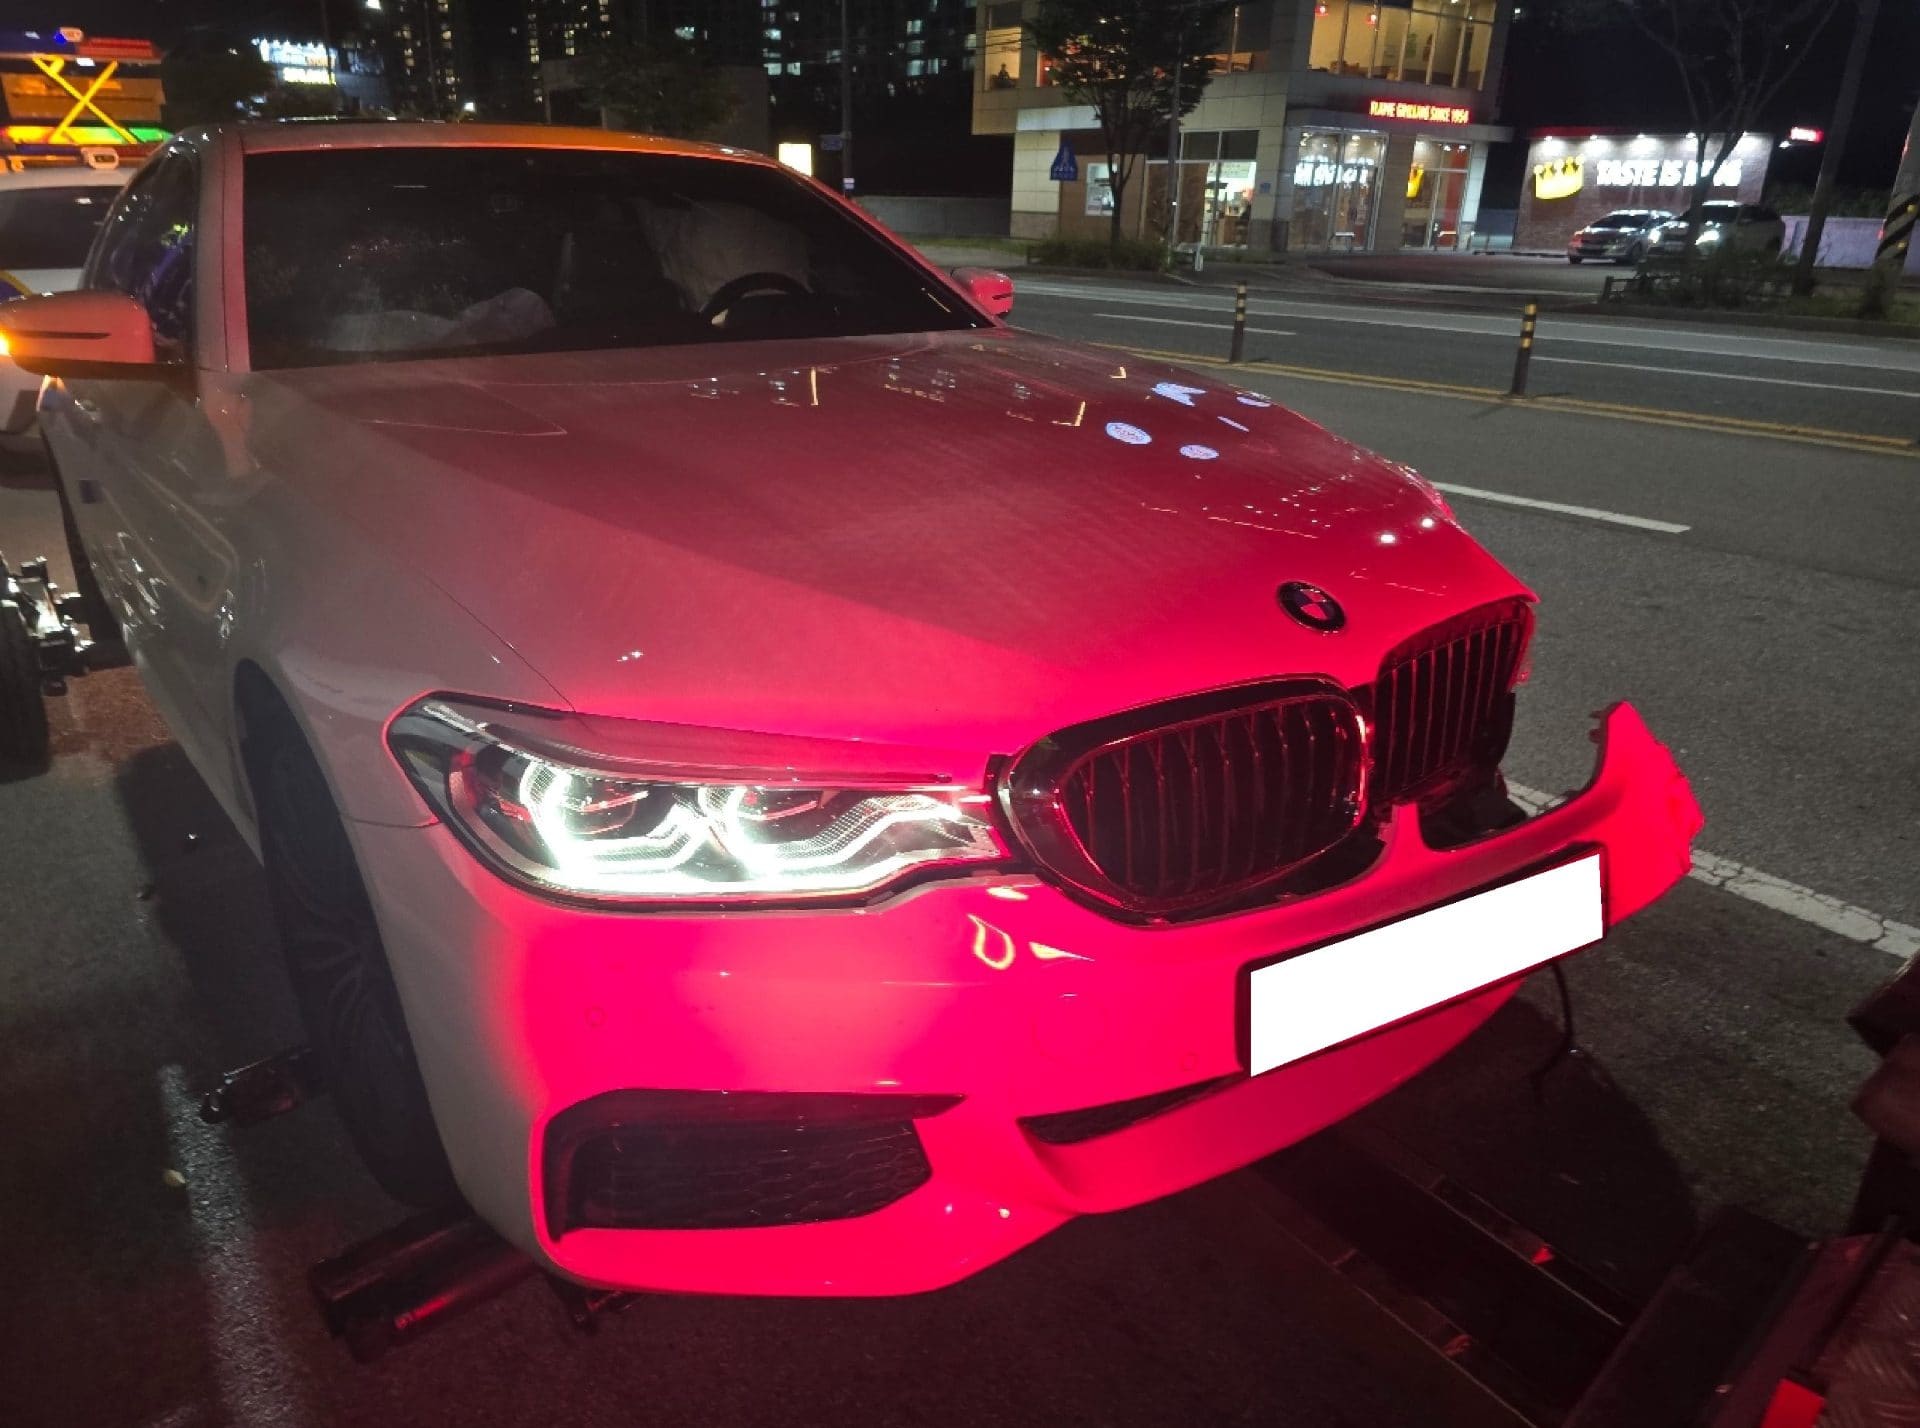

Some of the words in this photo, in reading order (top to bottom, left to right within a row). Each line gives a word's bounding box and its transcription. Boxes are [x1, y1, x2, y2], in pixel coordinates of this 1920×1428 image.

[1370, 100, 1396, 117] FLAME
[1430, 106, 1451, 122] SINCE
[1451, 108, 1469, 123] 1954
[1597, 160, 1659, 186] TASTE
[1659, 160, 1684, 187] IS
